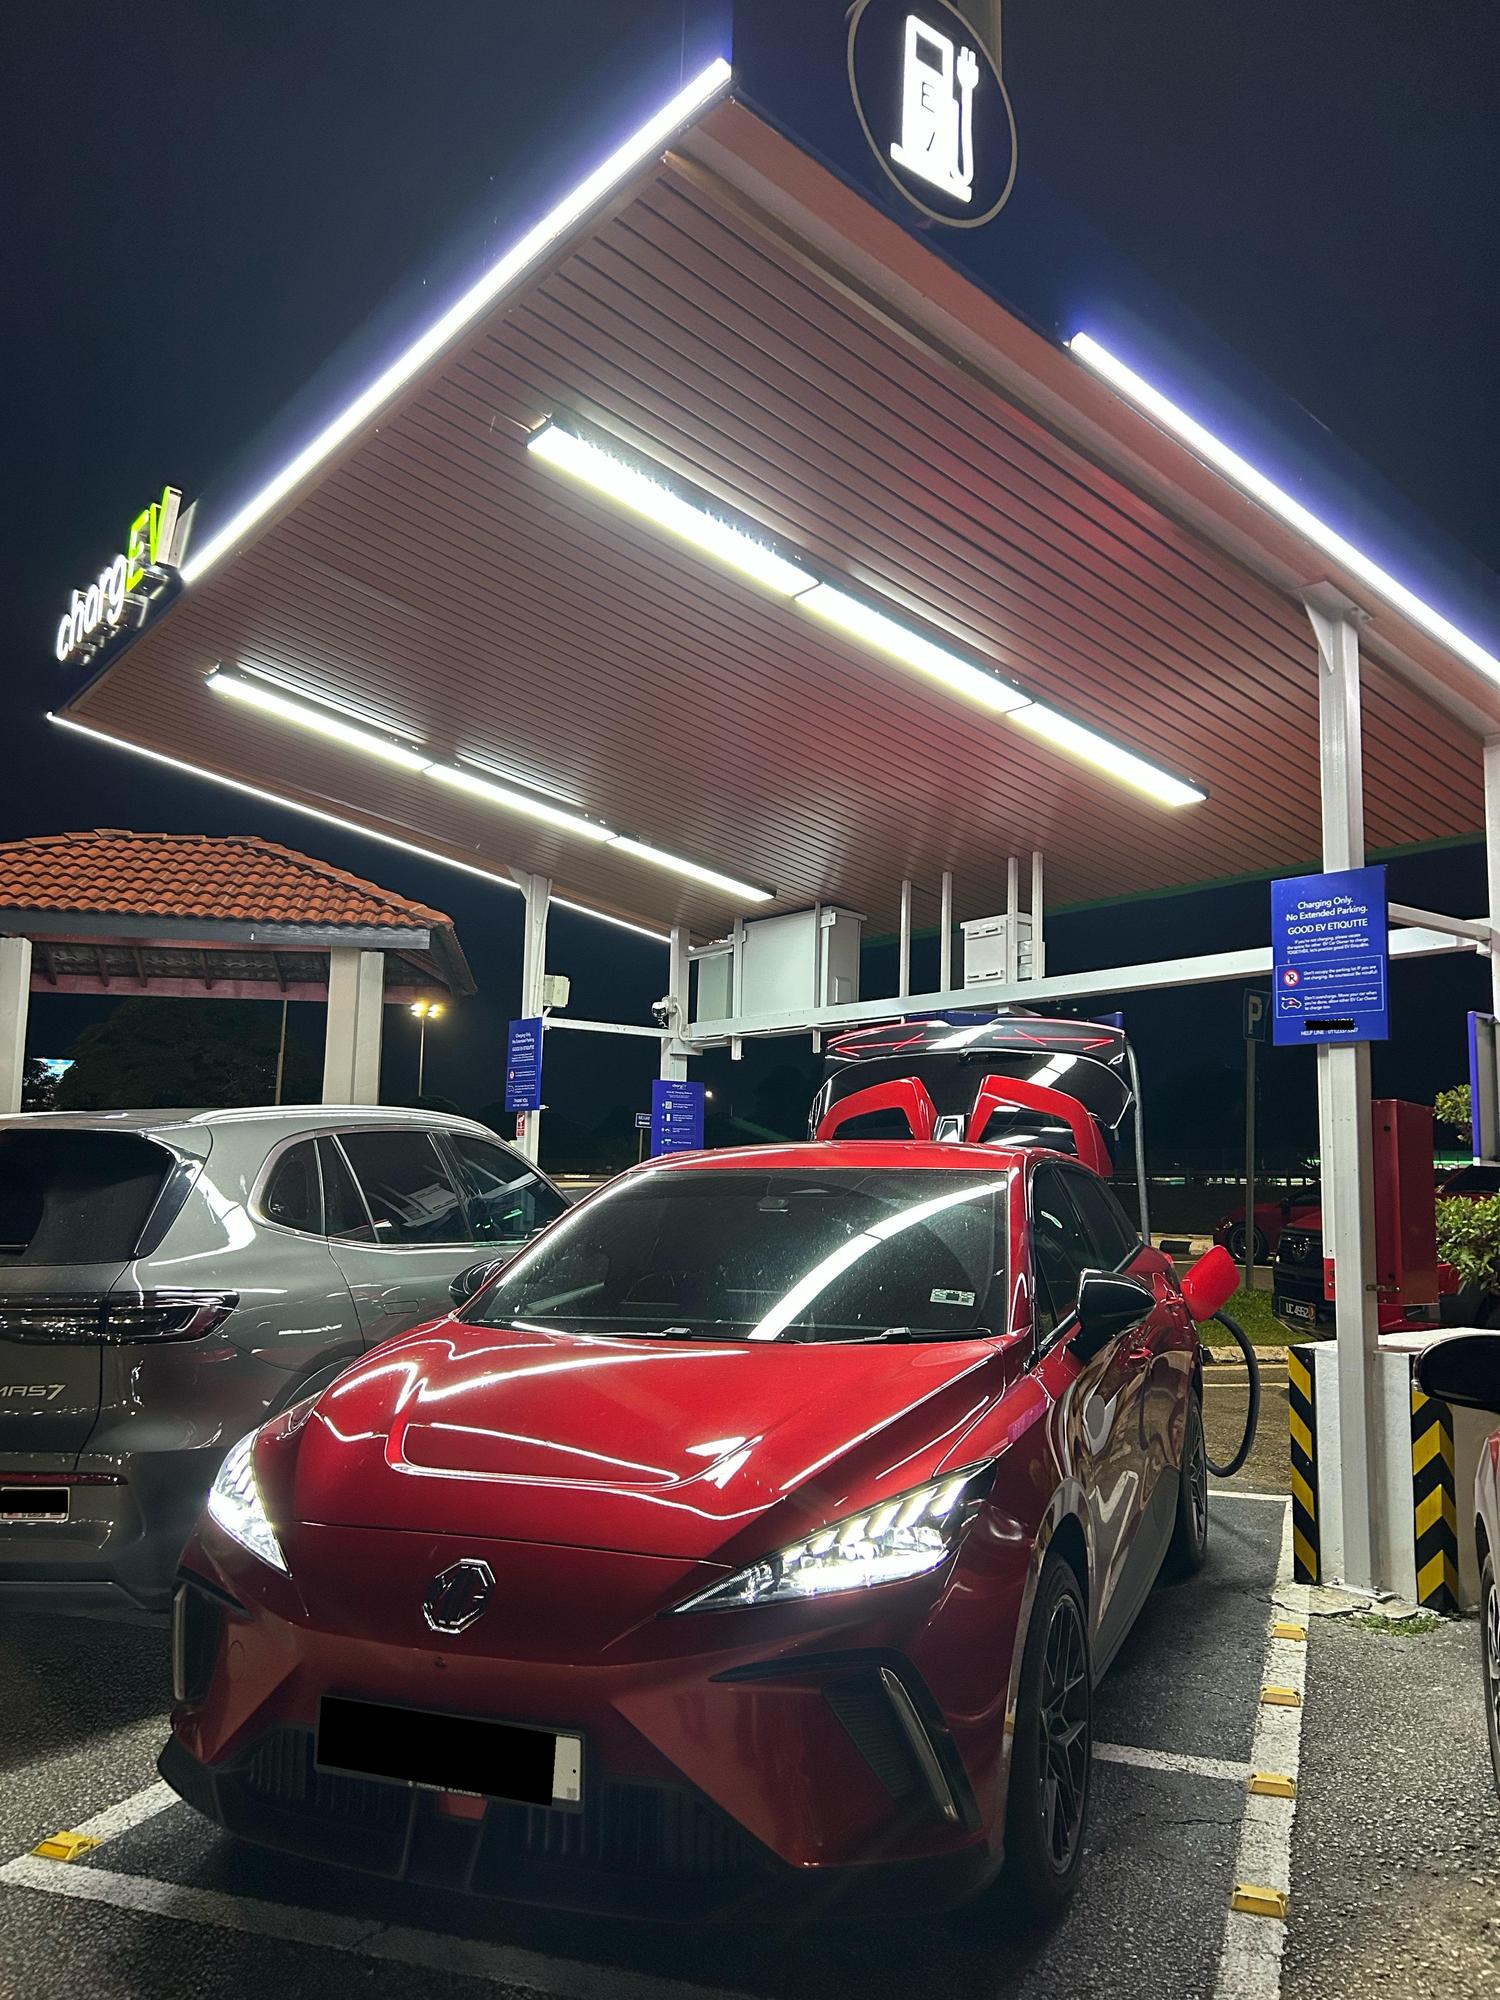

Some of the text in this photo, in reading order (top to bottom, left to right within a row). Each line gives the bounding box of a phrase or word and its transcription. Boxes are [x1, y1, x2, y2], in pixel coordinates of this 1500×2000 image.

[1297, 896, 1353, 909] Charging Only.
[1285, 905, 1368, 921] No Extended Parking.
[1287, 918, 1368, 935] GOOD EV ETIQUTTE
[1248, 995, 1262, 1034] P
